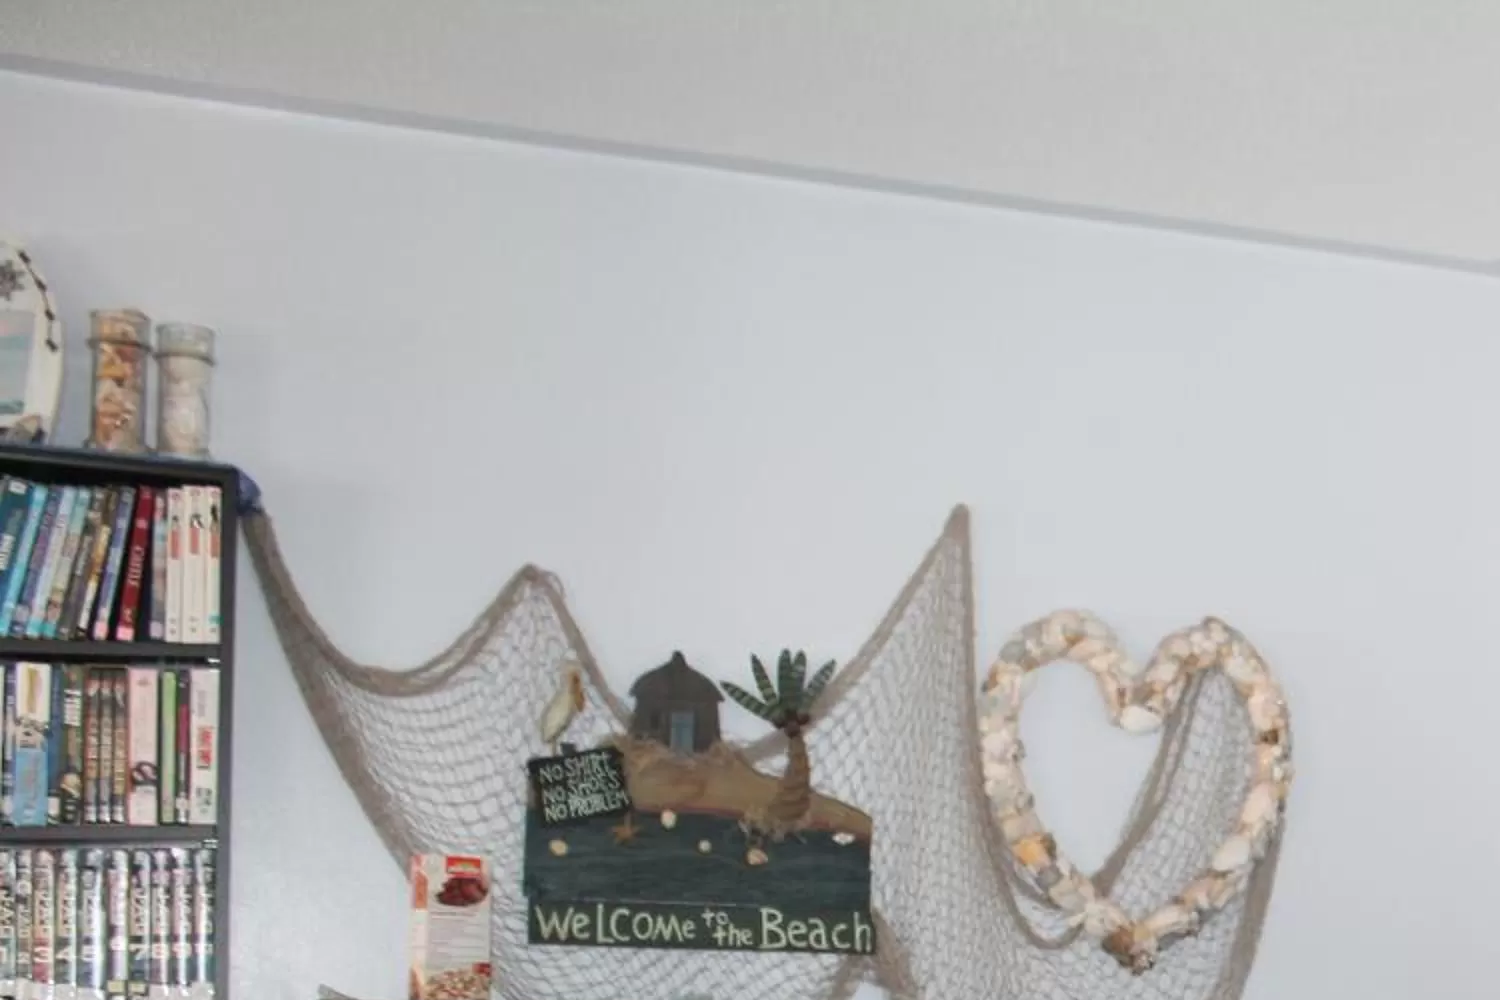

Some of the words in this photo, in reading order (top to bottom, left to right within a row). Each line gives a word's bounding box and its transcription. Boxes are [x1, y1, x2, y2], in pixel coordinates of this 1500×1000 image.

[540, 764, 564, 784] NO
[564, 752, 611, 778] SHIRT
[543, 785, 567, 805] NO
[567, 768, 621, 799] SHOES
[544, 802, 568, 823] NO
[567, 790, 630, 818] PROBLEM
[702, 908, 729, 927] to
[712, 918, 754, 947] the
[759, 906, 873, 952] Beach
